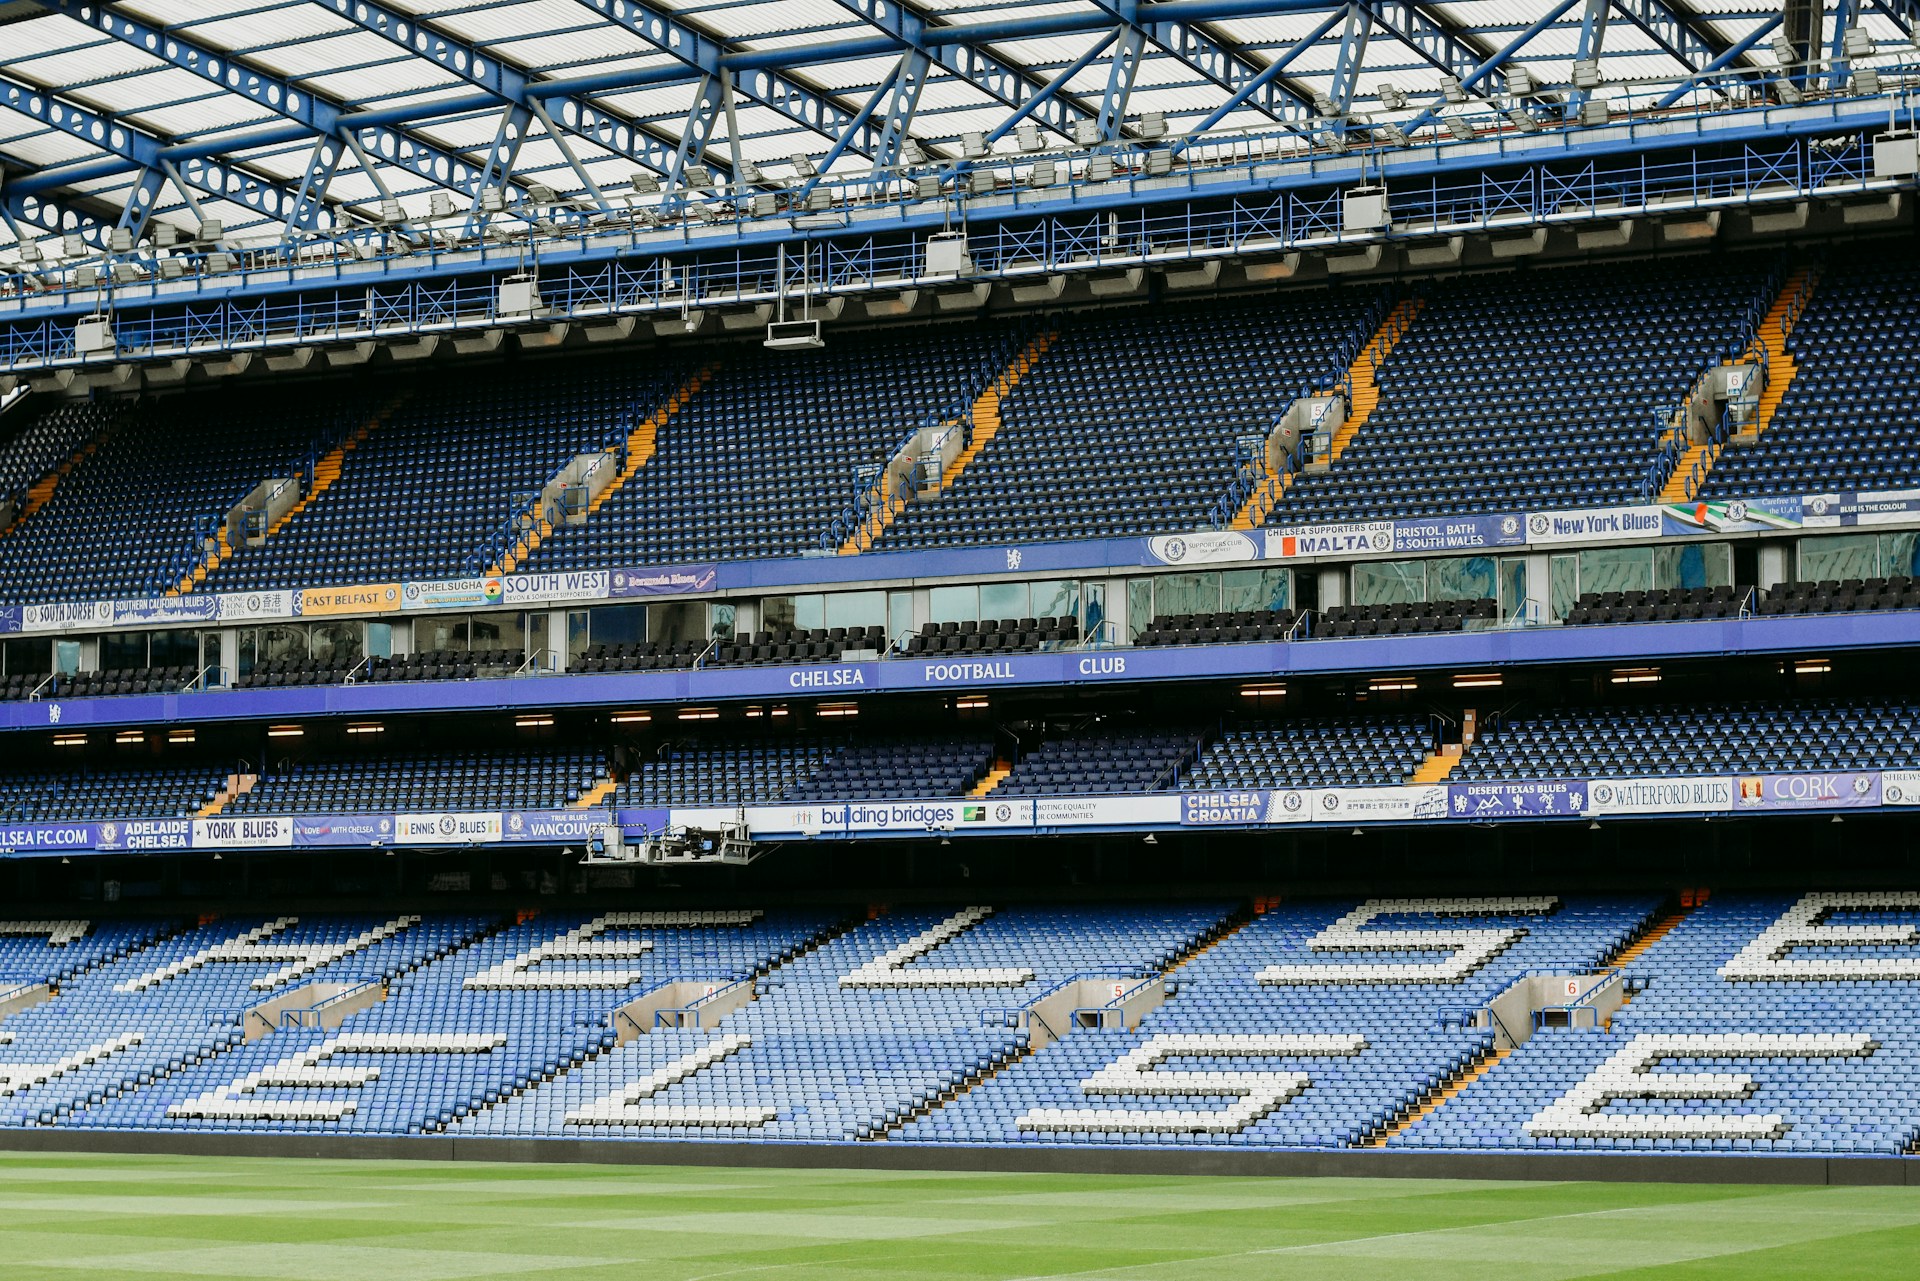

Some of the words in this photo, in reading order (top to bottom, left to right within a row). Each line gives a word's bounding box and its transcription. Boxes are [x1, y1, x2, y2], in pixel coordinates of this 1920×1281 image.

[1762, 498, 1790, 506] Carefree
[1840, 505, 1857, 513] BLUE
[1866, 504, 1877, 512] THE
[1879, 502, 1907, 511] COLOUR
[1268, 528, 1305, 537] CHELSEA
[1309, 524, 1366, 535] SUPPORTERS
[1369, 522, 1392, 531] CLUB
[1396, 526, 1444, 538] BRISTOL,
[1447, 524, 1475, 534] BATH
[1554, 518, 1584, 535] New
[1586, 515, 1619, 532] York
[1623, 513, 1659, 530] Blues
[1300, 535, 1370, 553] MALTA
[1396, 540, 1402, 550] &
[1406, 537, 1444, 549] SOUTH
[1447, 535, 1483, 546] WALES
[421, 581, 483, 593] CHELSUGHA
[507, 575, 559, 593] SOUTH
[566, 572, 607, 589] WEST
[629, 576, 669, 587] Bermuda
[671, 574, 696, 584] Blues
[263, 594, 281, 608] 香港
[306, 596, 331, 607] EAST
[335, 593, 379, 605] BELFAST
[560, 591, 592, 599] SUPPORTERS
[116, 600, 148, 611] SOUTHERN
[149, 597, 184, 609] CALIFORNIA
[185, 596, 205, 606] BLUES
[40, 605, 65, 622] SOUTH
[67, 602, 96, 620] DORSET
[790, 668, 864, 688] CHELSEA
[926, 663, 1015, 681] FOOTBALL
[1079, 657, 1125, 674] CLUB
[1468, 786, 1503, 796] DESERT
[1506, 785, 1534, 795] TEXAS
[1537, 784, 1567, 793] BLUES
[1774, 775, 1839, 799] CORK
[1187, 793, 1261, 808] CHELSEA
[1615, 783, 1690, 806] WATERFORD
[1694, 783, 1728, 804] BLUES
[1064, 803, 1097, 811] EQUALITY
[892, 804, 954, 826] bridges
[1046, 812, 1094, 820] COMMUNITIES
[1188, 807, 1258, 822] CROATIA
[125, 822, 188, 835] ADELAIDE
[206, 822, 236, 839] YORK
[242, 820, 278, 838] BLUES
[305, 826, 320, 835] LOVE
[331, 826, 347, 834] WITH
[348, 825, 374, 834] CHELSEA
[411, 823, 435, 835] ENNIS
[460, 821, 486, 834] BLUES
[127, 834, 187, 848] CHELSEA
[1115, 985, 1123, 997] 5
[1568, 982, 1576, 995] 6
